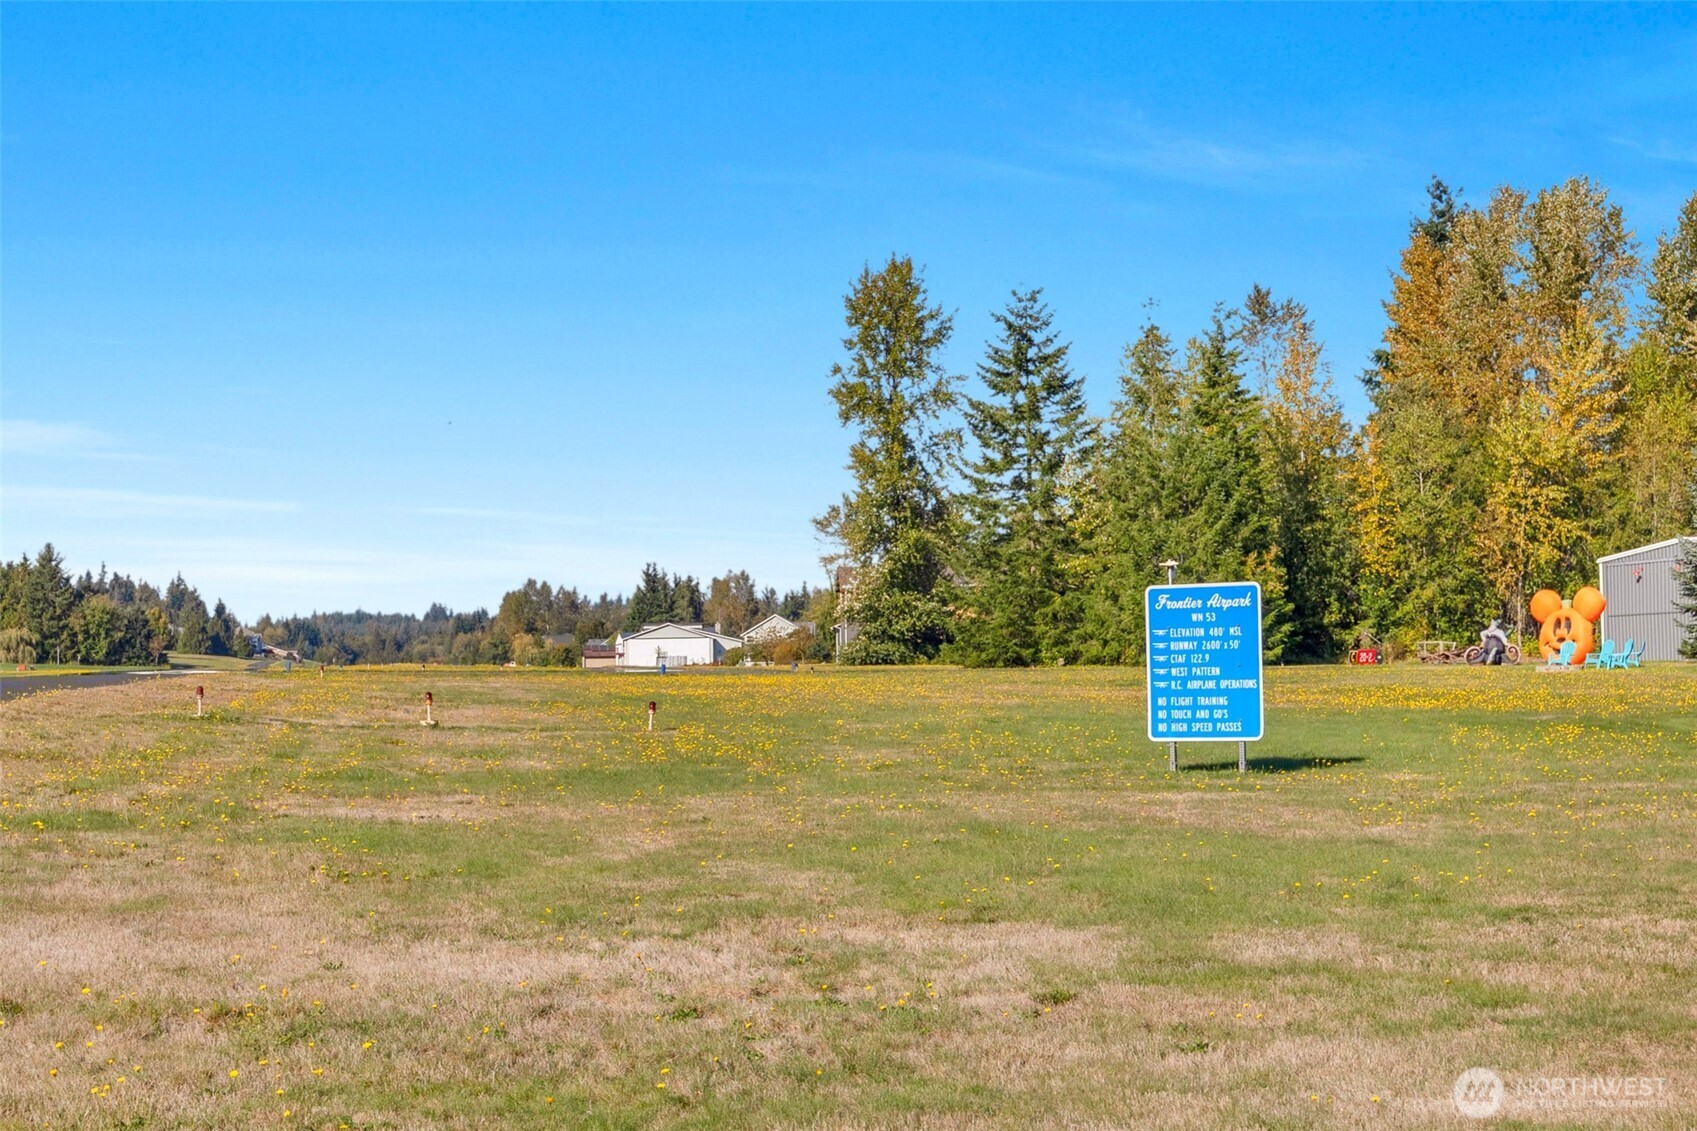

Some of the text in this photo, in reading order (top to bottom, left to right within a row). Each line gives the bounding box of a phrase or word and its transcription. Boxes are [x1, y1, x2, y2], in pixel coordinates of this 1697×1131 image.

[1155, 592, 1252, 611] Frontier Airpark
[1191, 612, 1216, 622] WN 53
[1170, 628, 1204, 638] ELEVATION
[1170, 641, 1198, 650] RUNWAY
[1170, 654, 1210, 664] CTAF 122.9
[1170, 666, 1220, 676] WEST PATTERN
[1172, 680, 1258, 690] R.C. AIRPLANE OPERATIONS
[1158, 696, 1228, 706] NO FLIGHT TRAINING
[1158, 710, 1228, 719] NO TOUCH AND GO'S
[1158, 722, 1242, 732] NO HIGH SPEED PASSES
